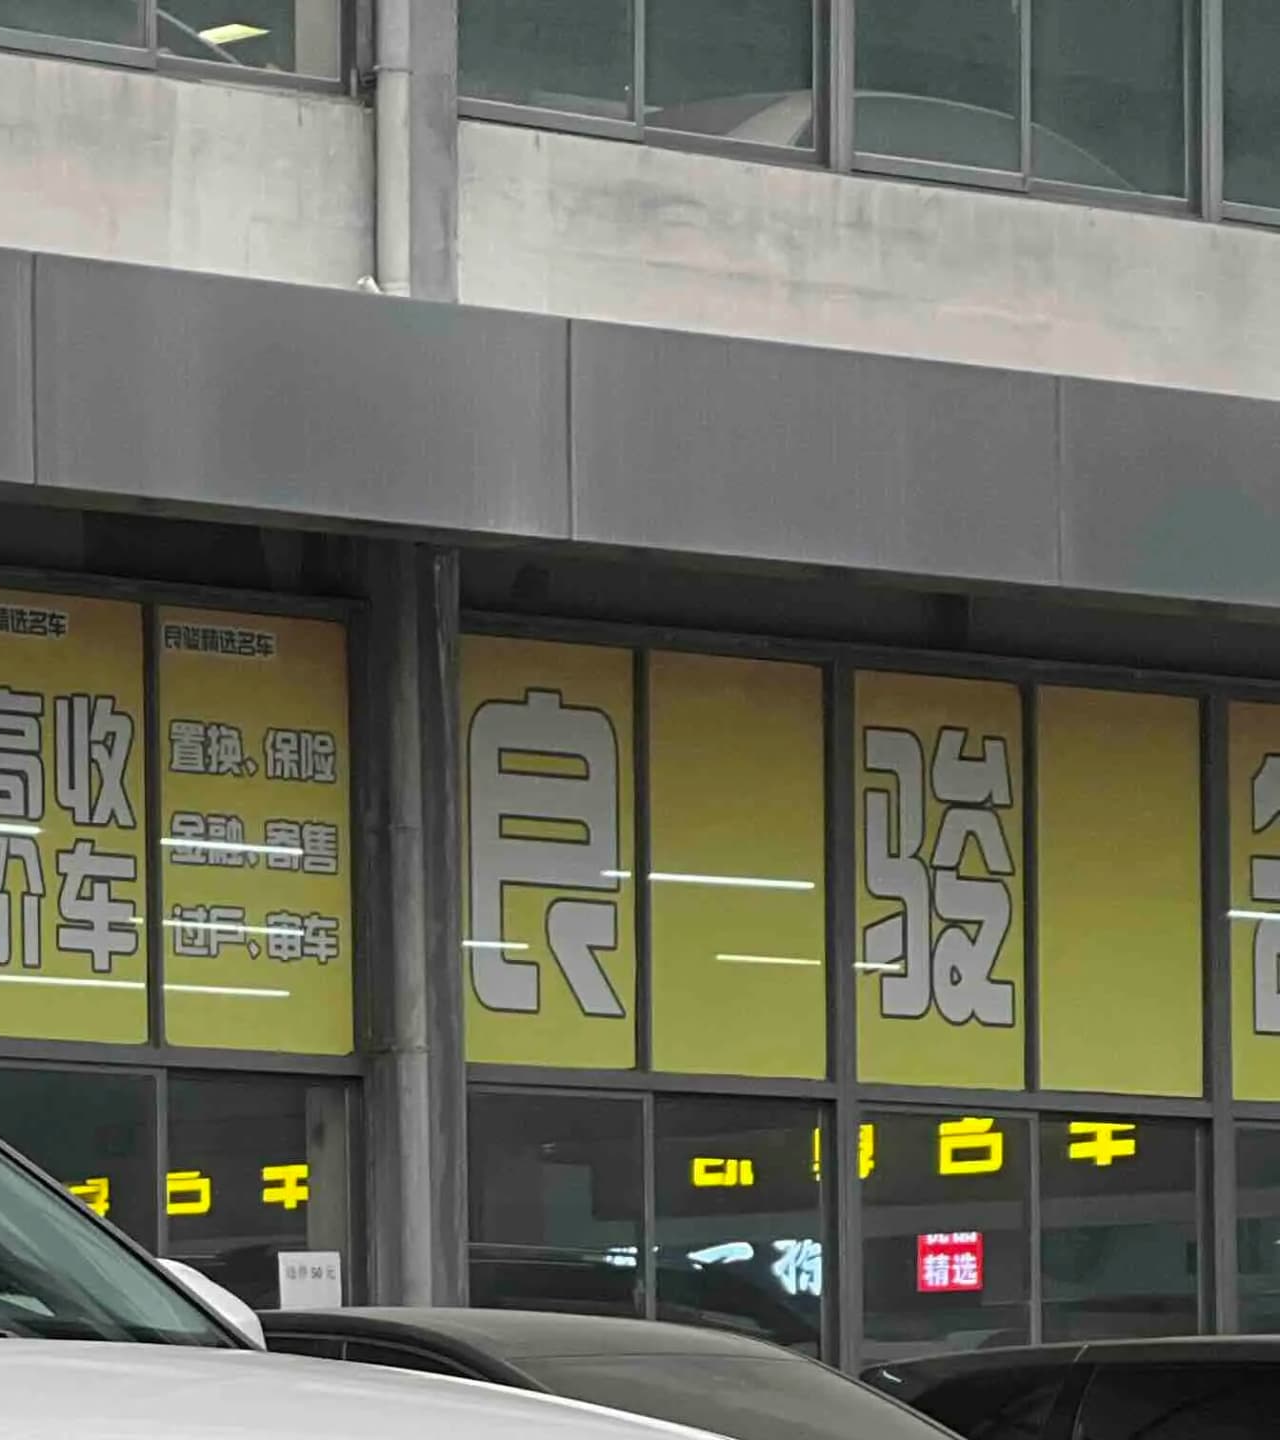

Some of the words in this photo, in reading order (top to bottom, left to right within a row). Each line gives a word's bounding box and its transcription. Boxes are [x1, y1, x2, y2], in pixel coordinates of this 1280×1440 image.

[164, 625, 275, 657] 良骏精选名车
